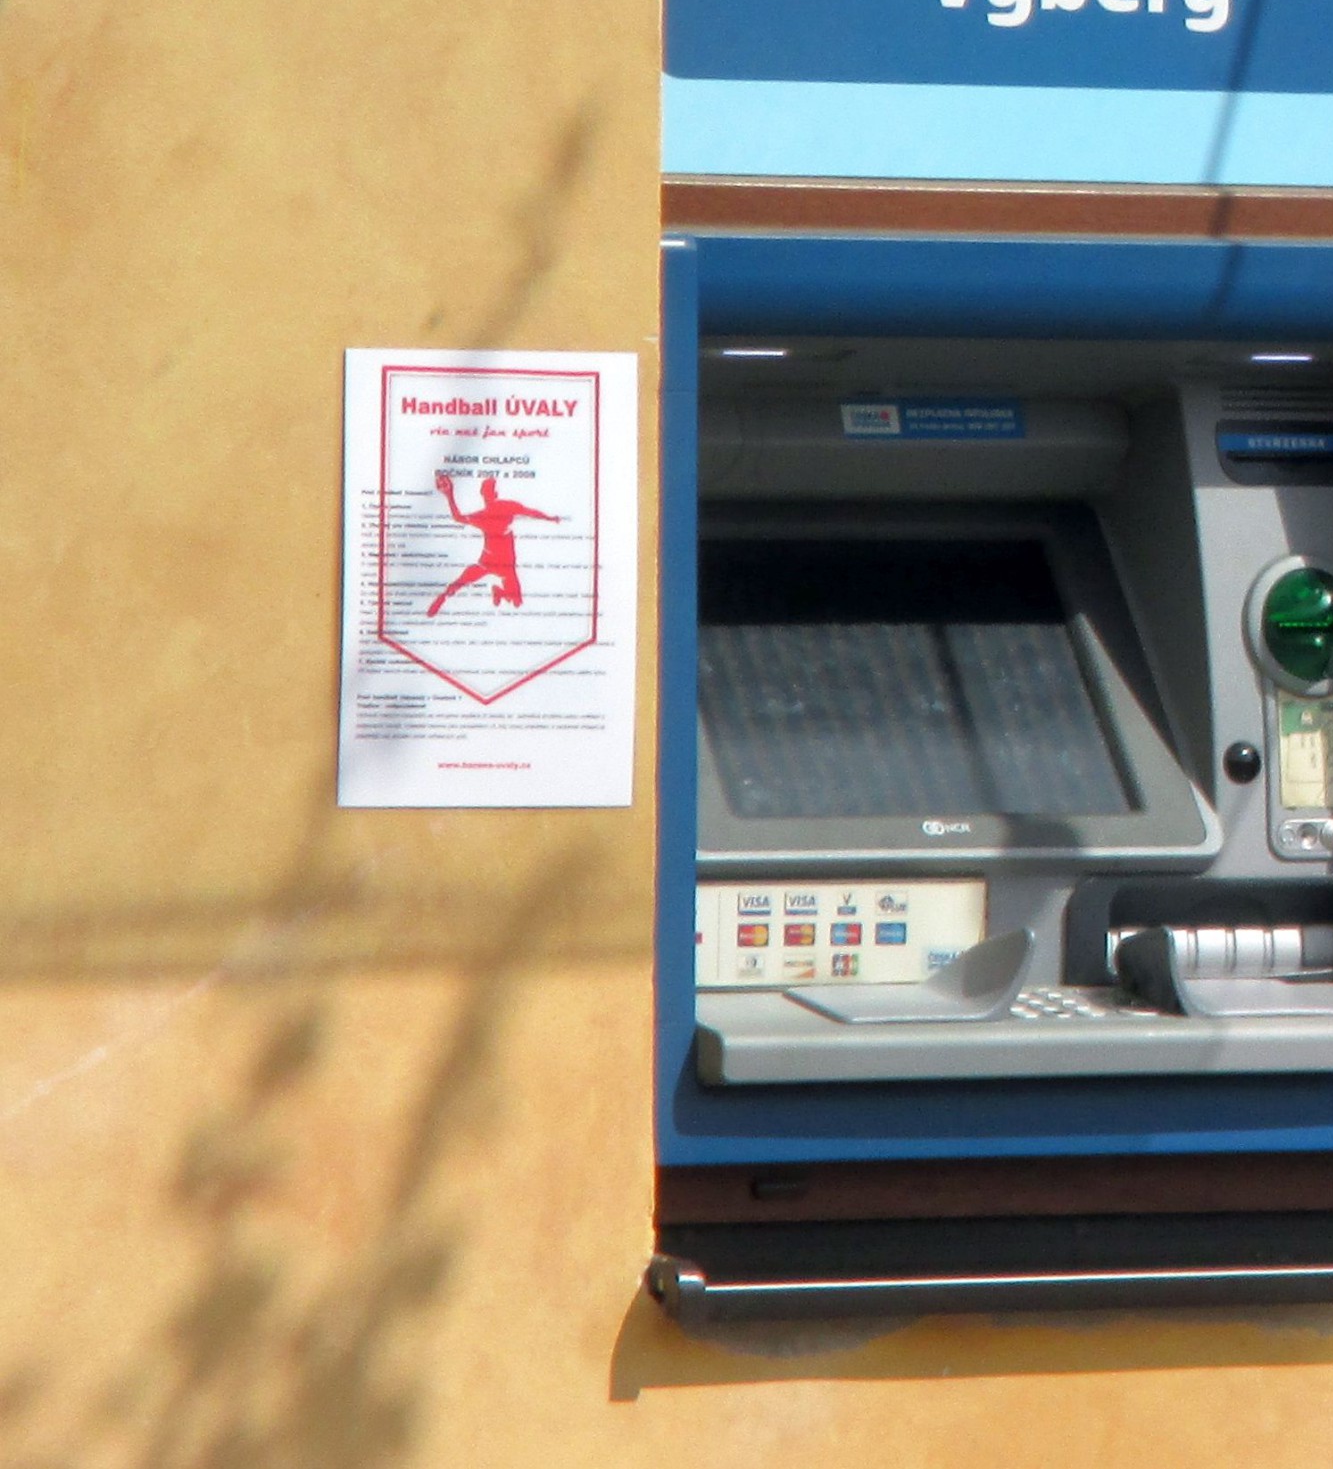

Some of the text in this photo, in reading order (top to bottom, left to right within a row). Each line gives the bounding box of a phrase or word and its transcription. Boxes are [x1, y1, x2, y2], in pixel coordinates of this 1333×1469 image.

[401, 395, 578, 417] Handball ÚVALY
[742, 895, 770, 908] VISA
[789, 895, 817, 907] VISA
